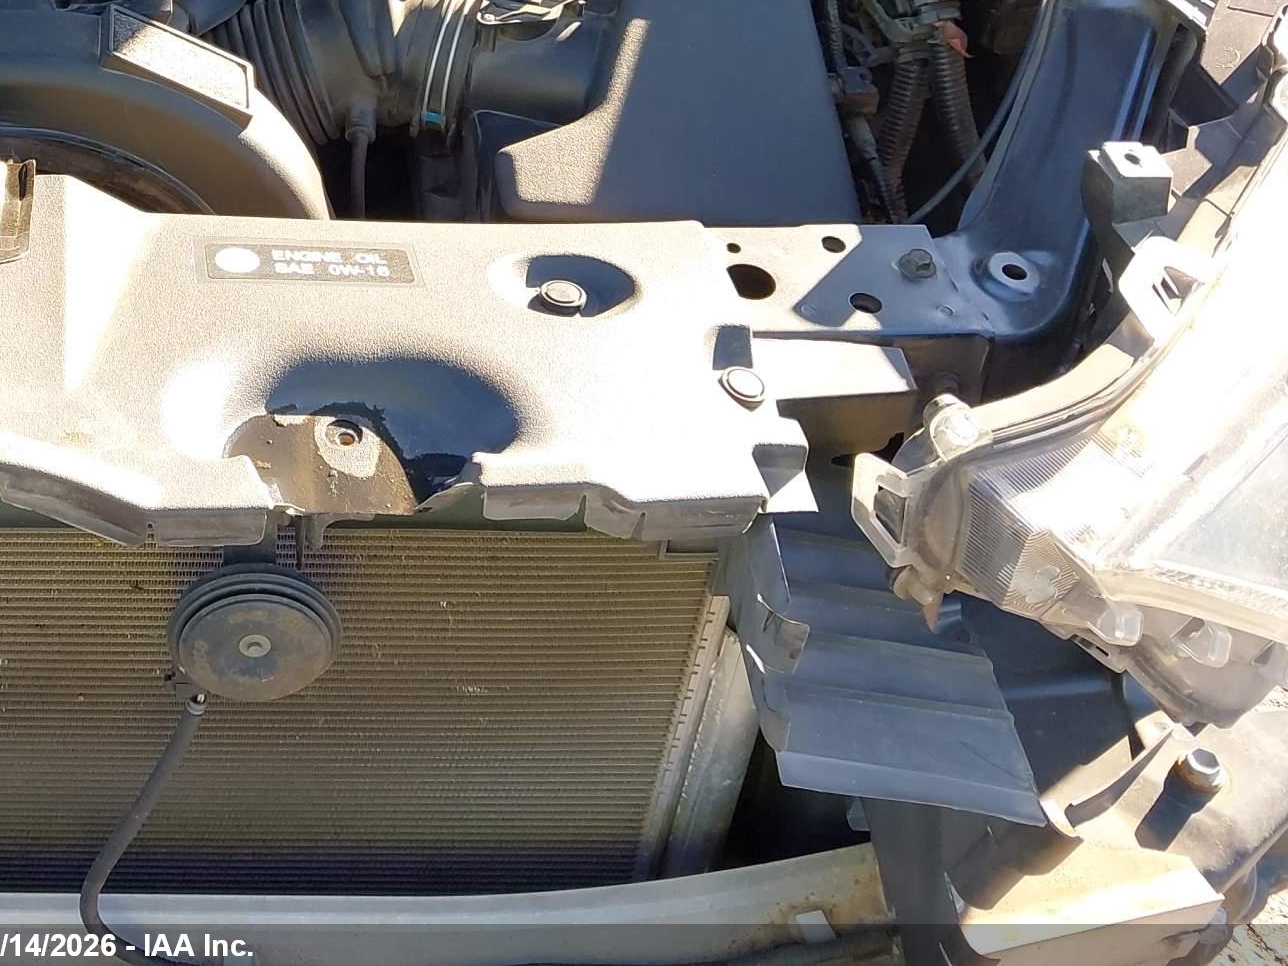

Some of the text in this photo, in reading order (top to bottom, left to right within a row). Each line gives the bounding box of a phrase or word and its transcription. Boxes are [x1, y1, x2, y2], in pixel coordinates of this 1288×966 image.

[271, 249, 389, 265] ENGINE OIL
[274, 262, 314, 275] SAE
